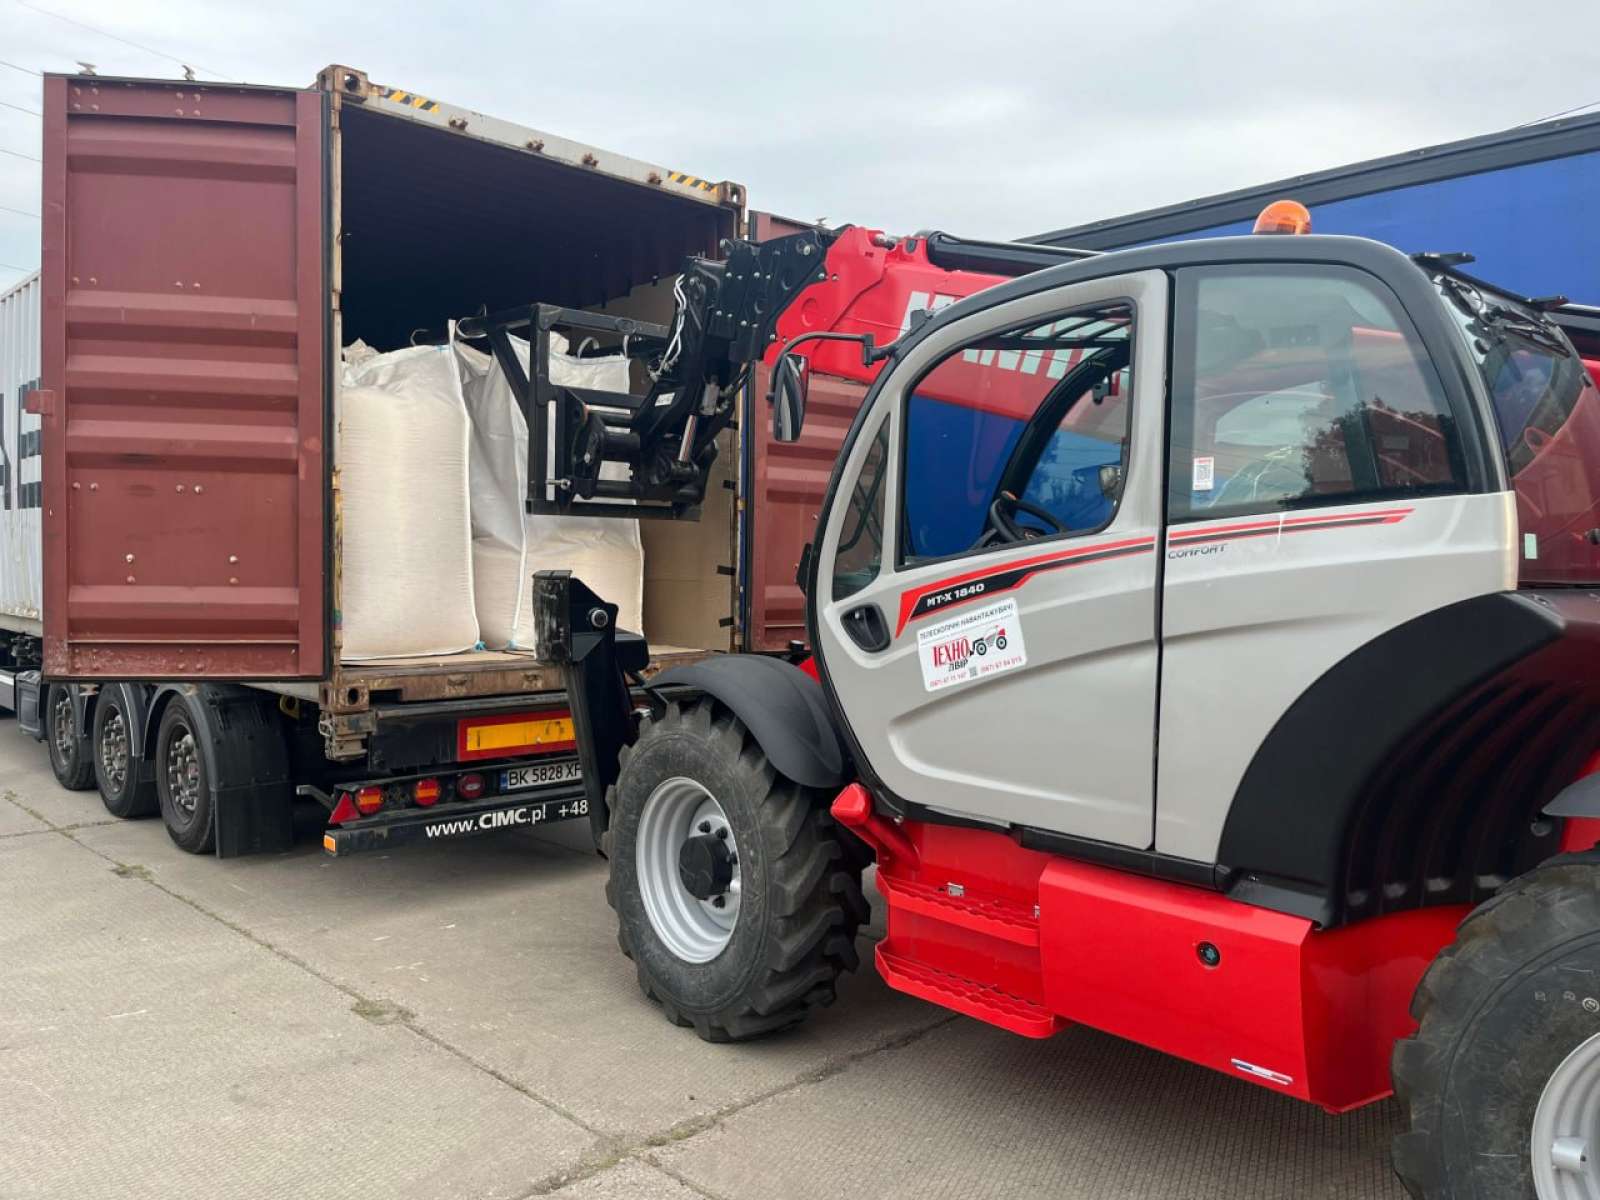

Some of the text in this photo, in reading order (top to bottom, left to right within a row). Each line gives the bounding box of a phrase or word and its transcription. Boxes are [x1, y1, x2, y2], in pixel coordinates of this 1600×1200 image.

[954, 583, 985, 599] 1840
[508, 769, 530, 786] BK
[532, 765, 562, 782] 5828
[425, 799, 589, 839] www.CIMC.pl +48
